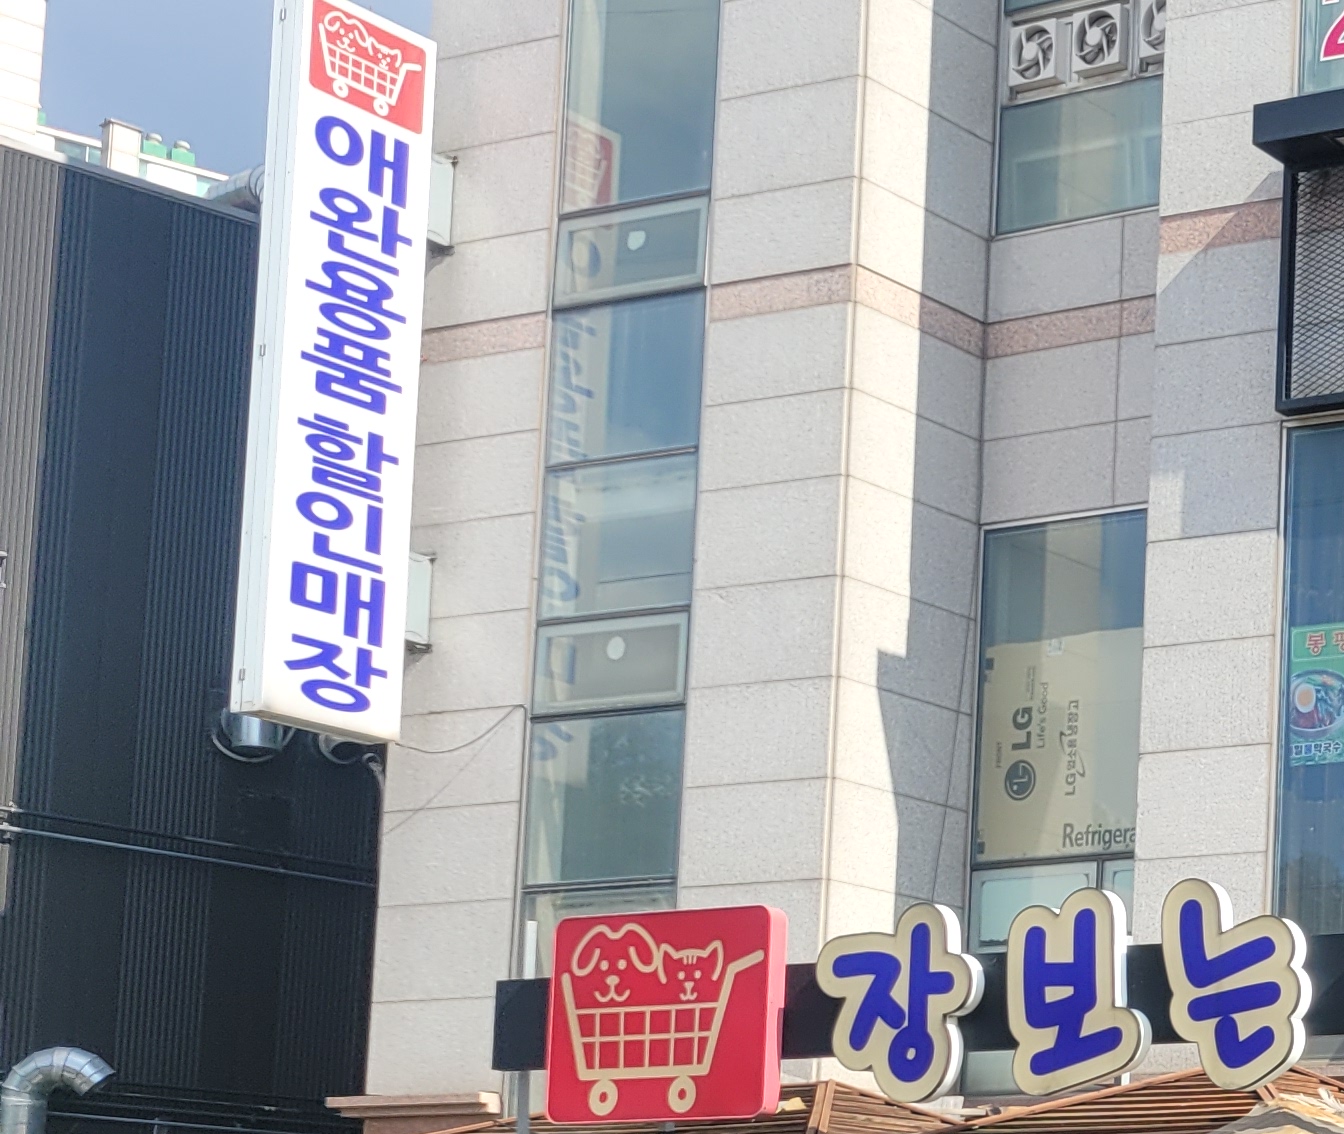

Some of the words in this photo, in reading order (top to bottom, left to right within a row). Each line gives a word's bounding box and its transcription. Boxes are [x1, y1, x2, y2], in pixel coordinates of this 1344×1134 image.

[300, 114, 413, 415] 애완용품
[284, 416, 400, 714] 할인매장
[1037, 681, 1049, 714] Good
[1011, 706, 1033, 751] LG
[1036, 717, 1047, 749] Life's
[1291, 742, 1342, 757] 밀물막국수
[1064, 772, 1077, 796] LG
[826, 891, 1290, 1090] 장보는
